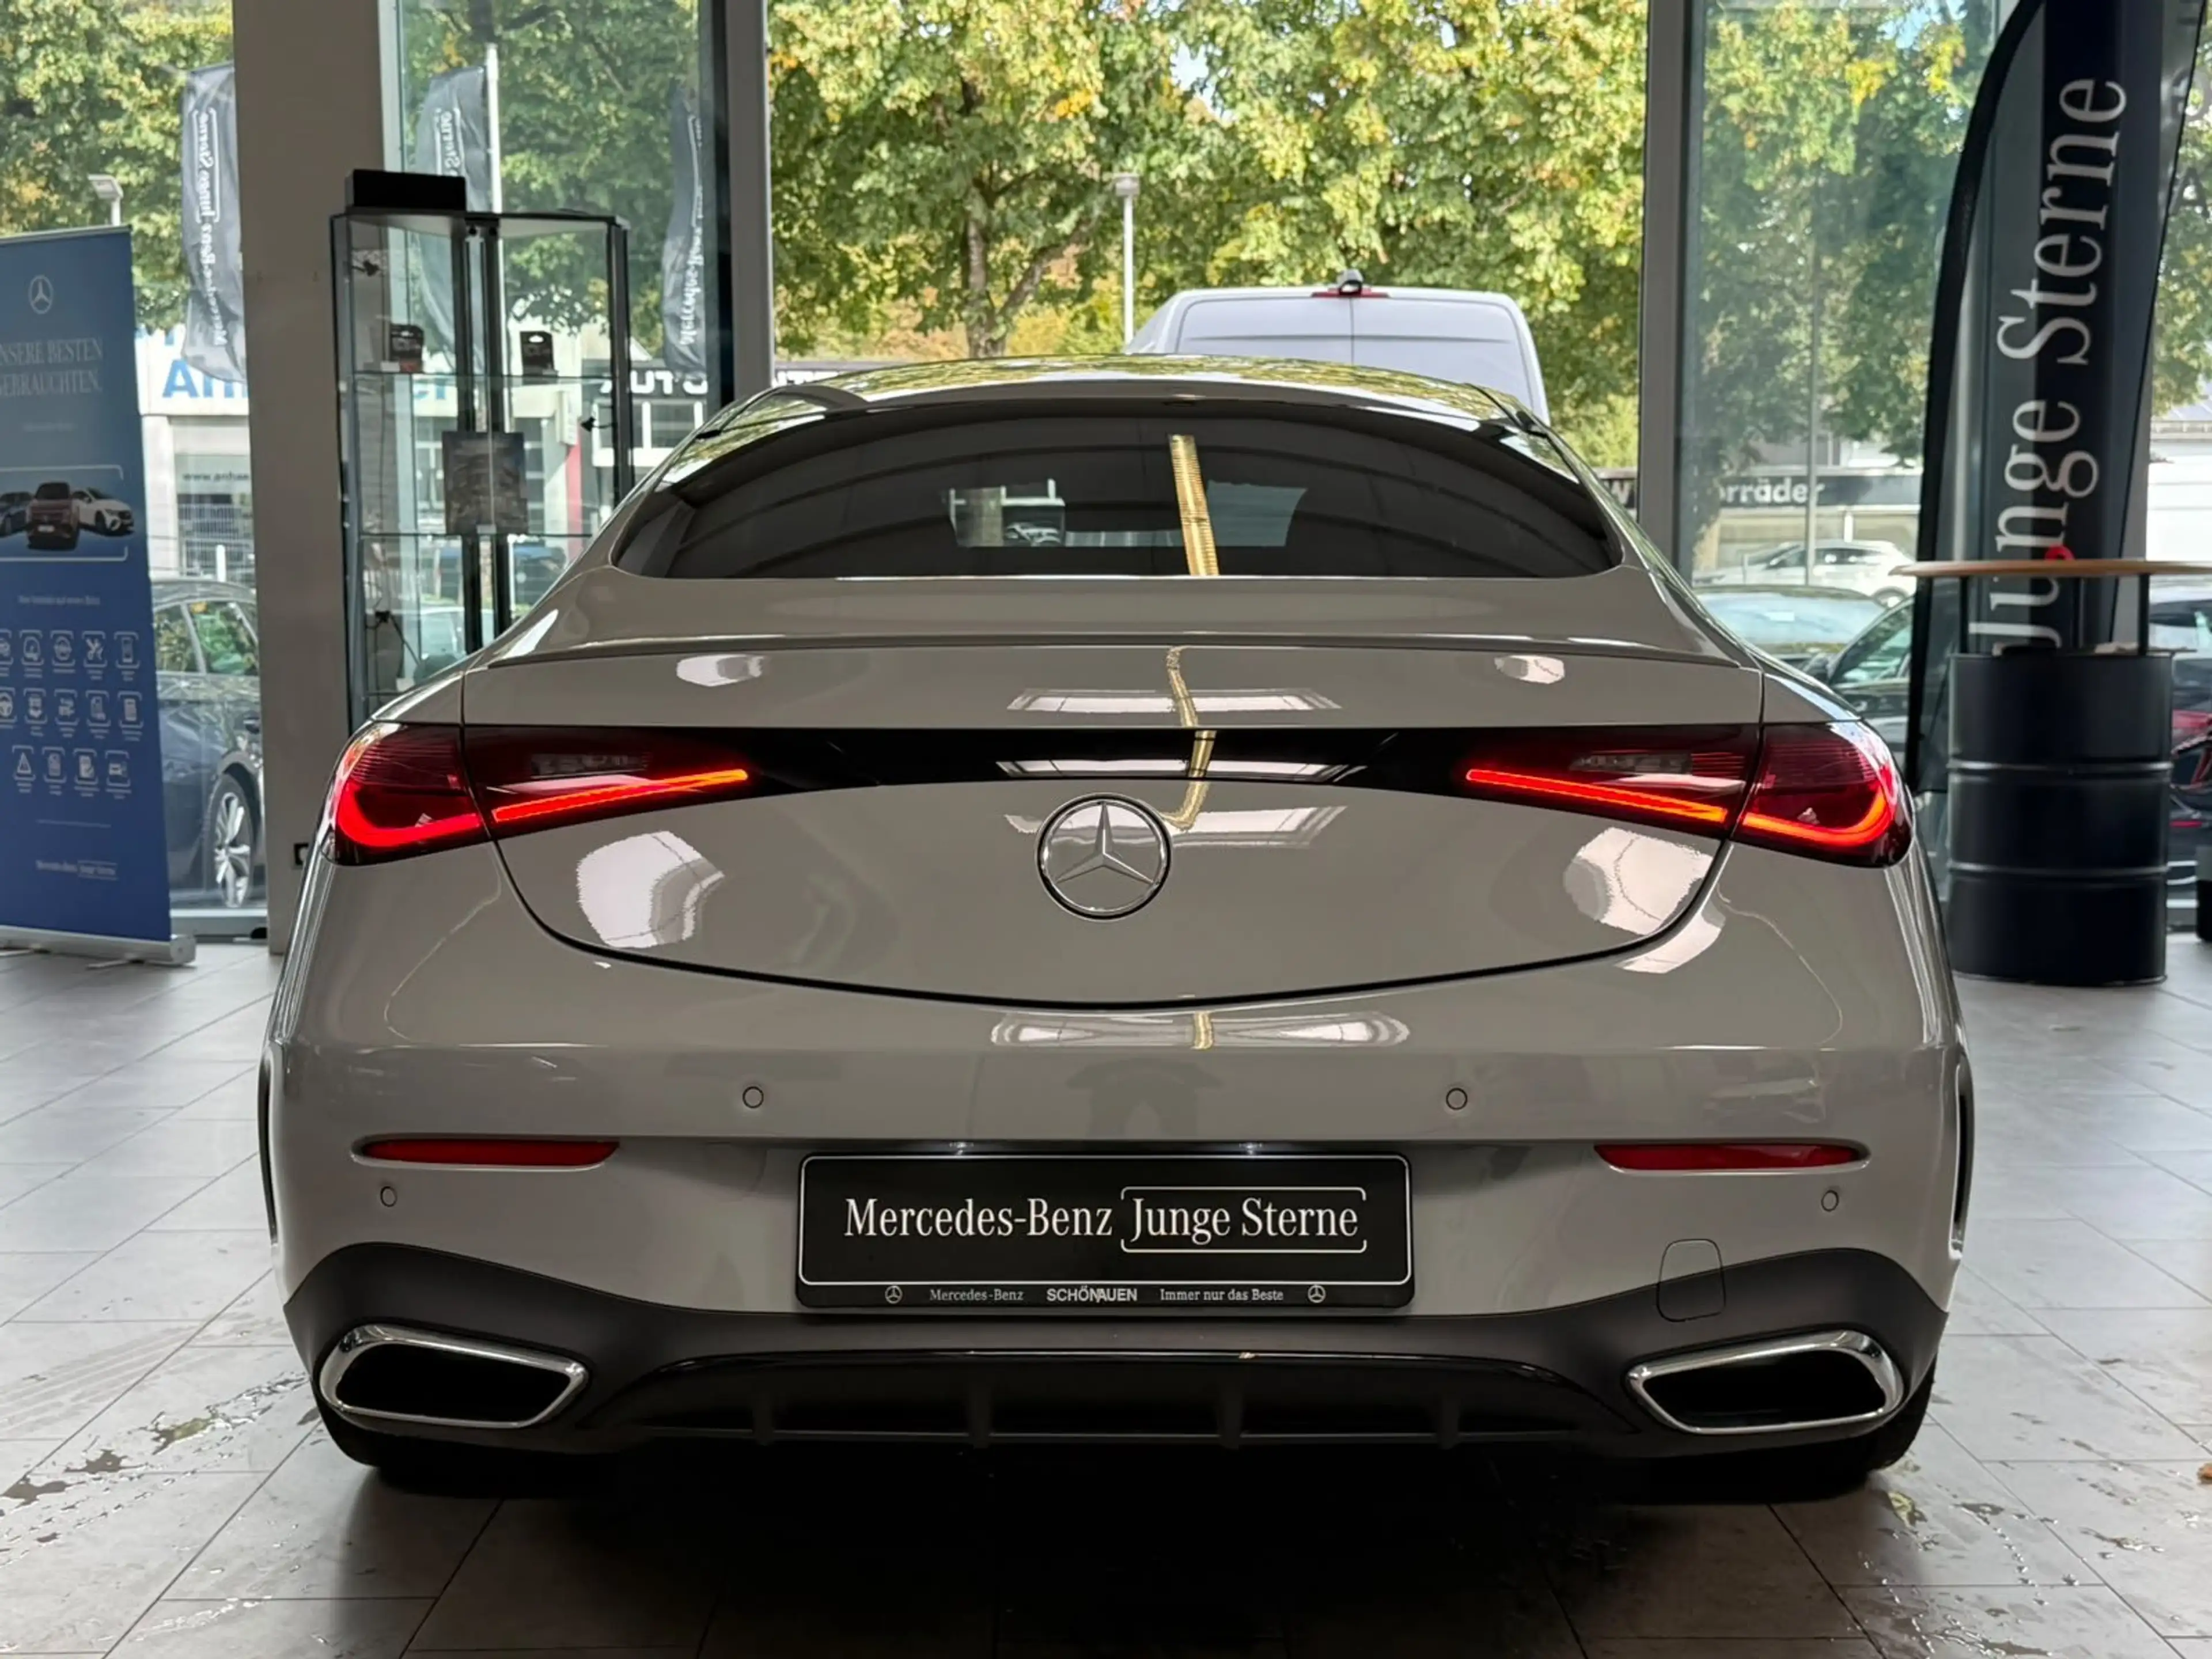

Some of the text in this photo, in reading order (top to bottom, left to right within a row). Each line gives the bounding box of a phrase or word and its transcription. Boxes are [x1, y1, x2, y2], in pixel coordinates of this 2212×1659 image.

[1997, 78, 2127, 366] Sterne
[1719, 478, 1825, 503] rräder
[844, 1198, 1358, 1245] Mercedes-Benz Junge Sterne
[930, 1285, 1284, 1303] Mercedes-Benz SCHÖNAUEN Immer nur das Beste
